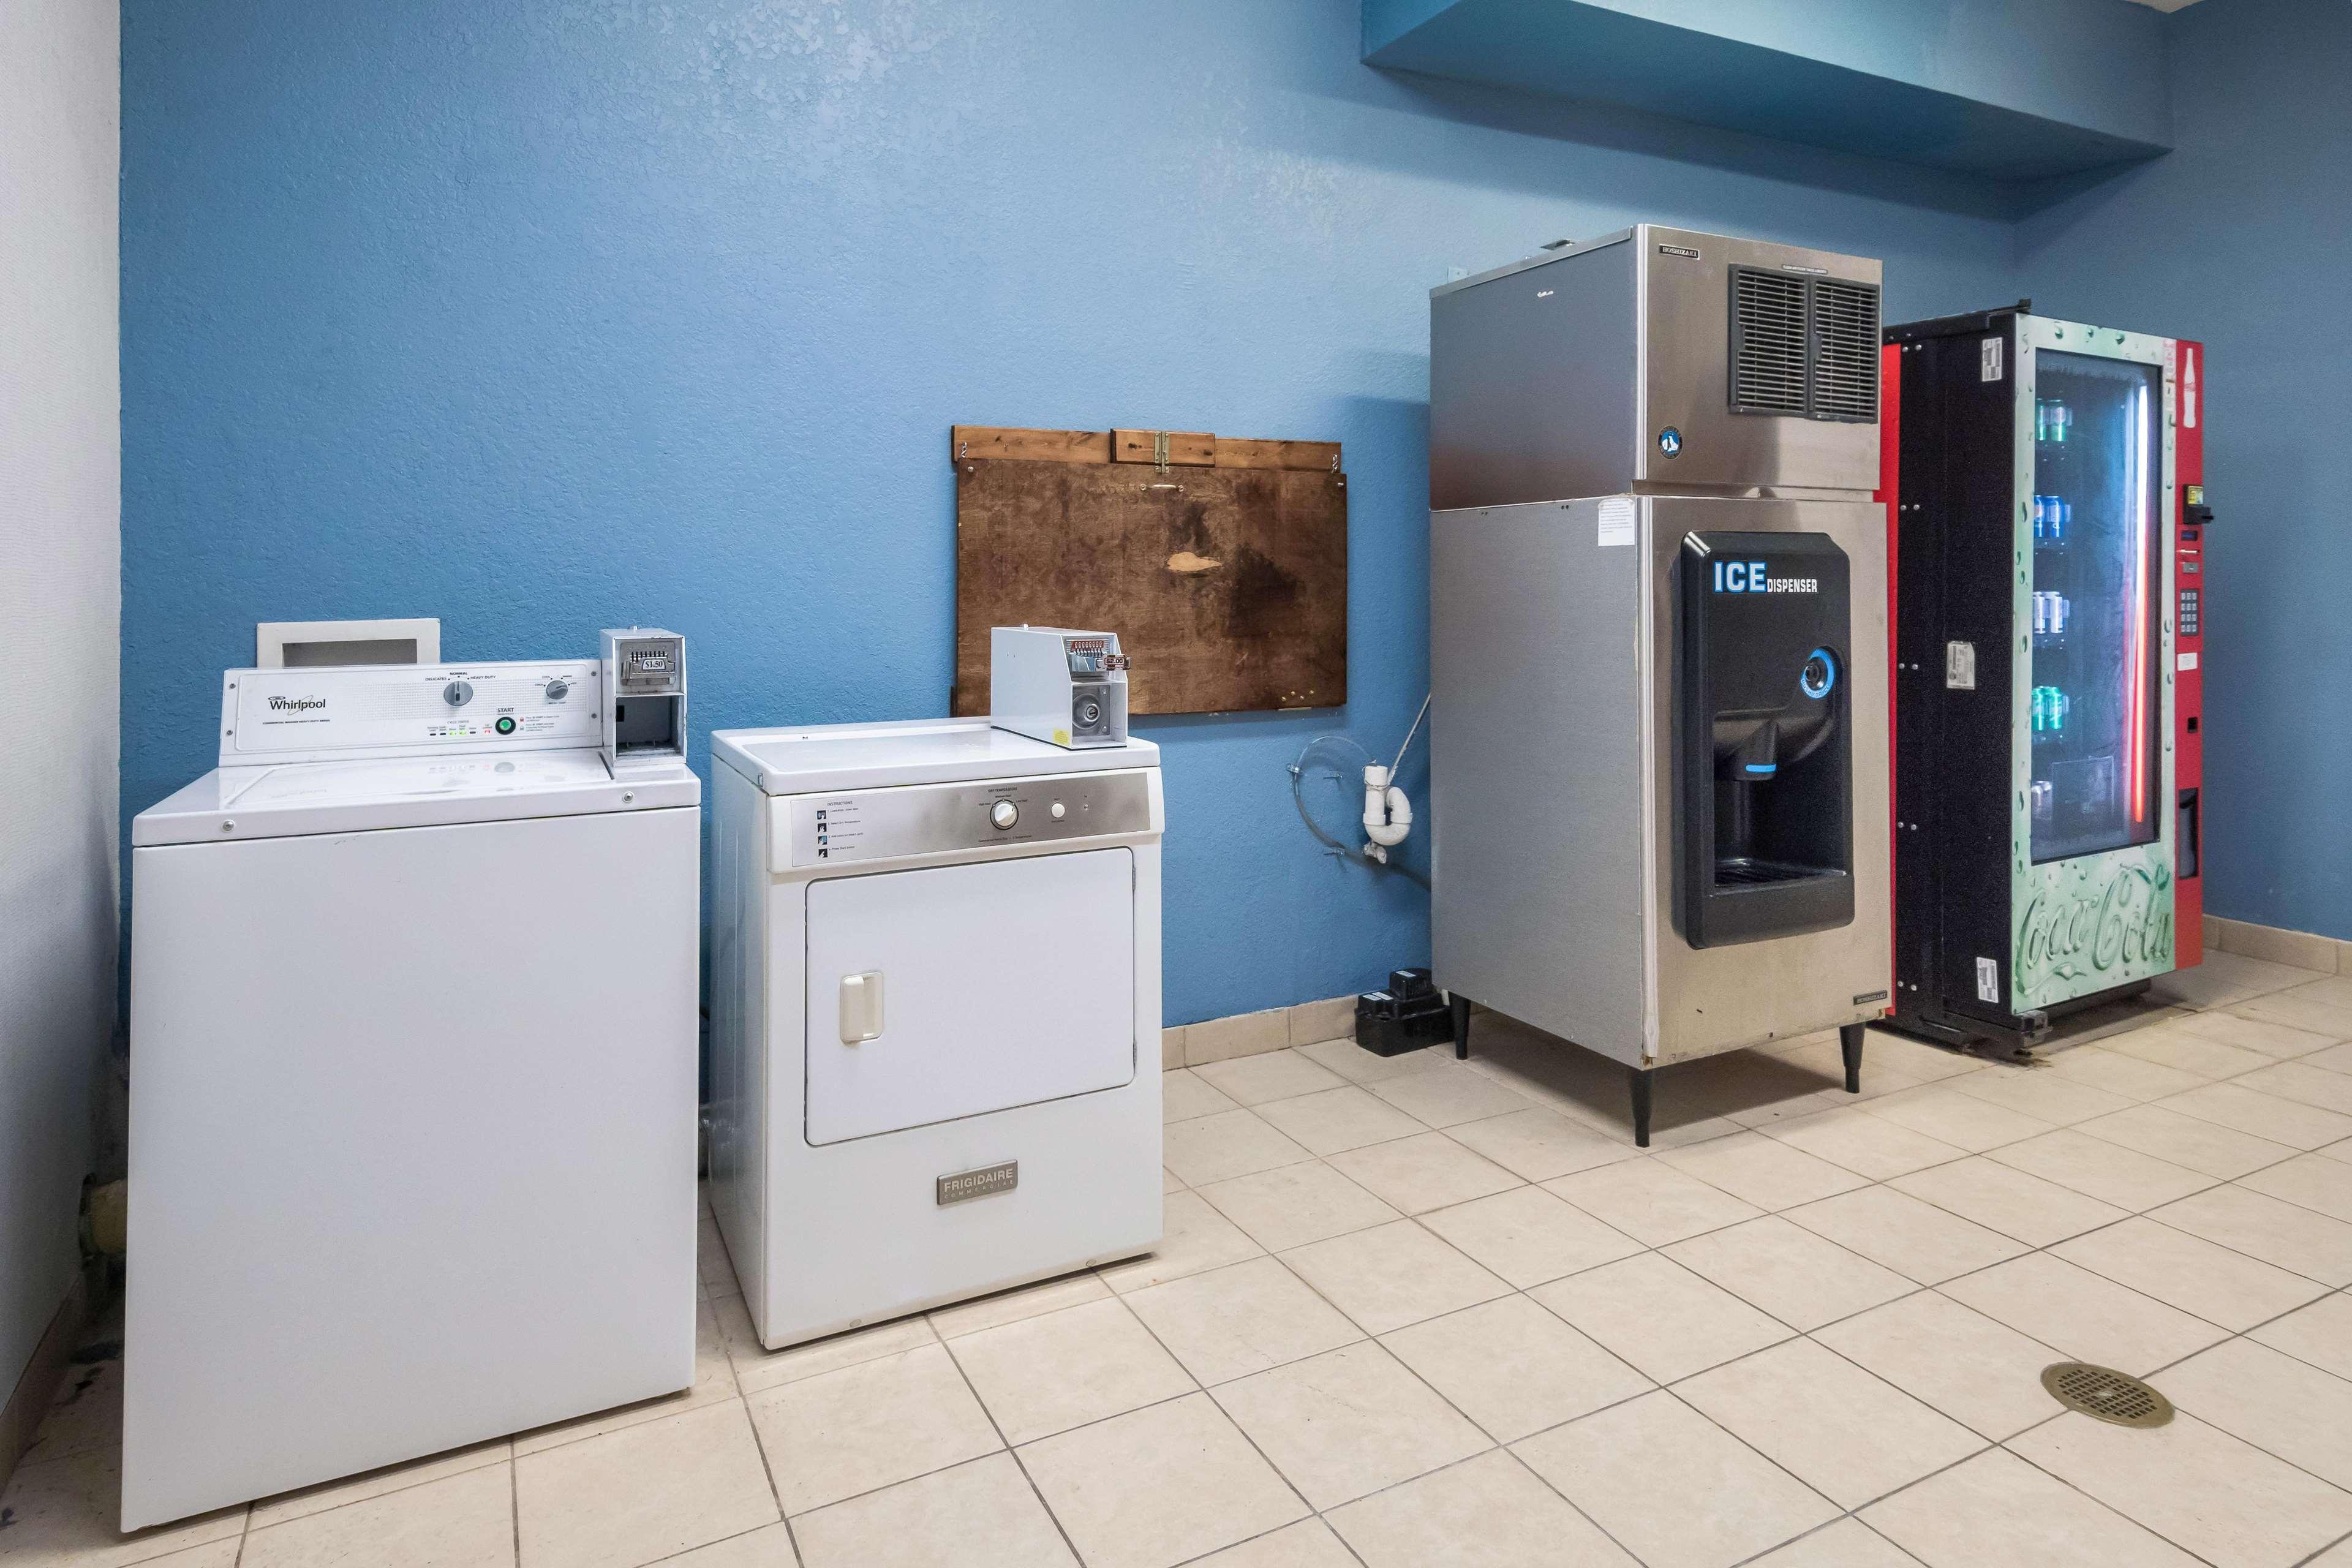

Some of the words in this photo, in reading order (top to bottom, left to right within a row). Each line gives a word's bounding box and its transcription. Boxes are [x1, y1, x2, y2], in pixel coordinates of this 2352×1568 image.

[1662, 246, 1697, 257] HOSHIZAKI
[1714, 561, 1766, 593] ICE
[1767, 578, 1817, 593] DISPENSER
[270, 698, 326, 711] Whirlpool
[944, 1168, 1014, 1193] FRIGIDAIRE
